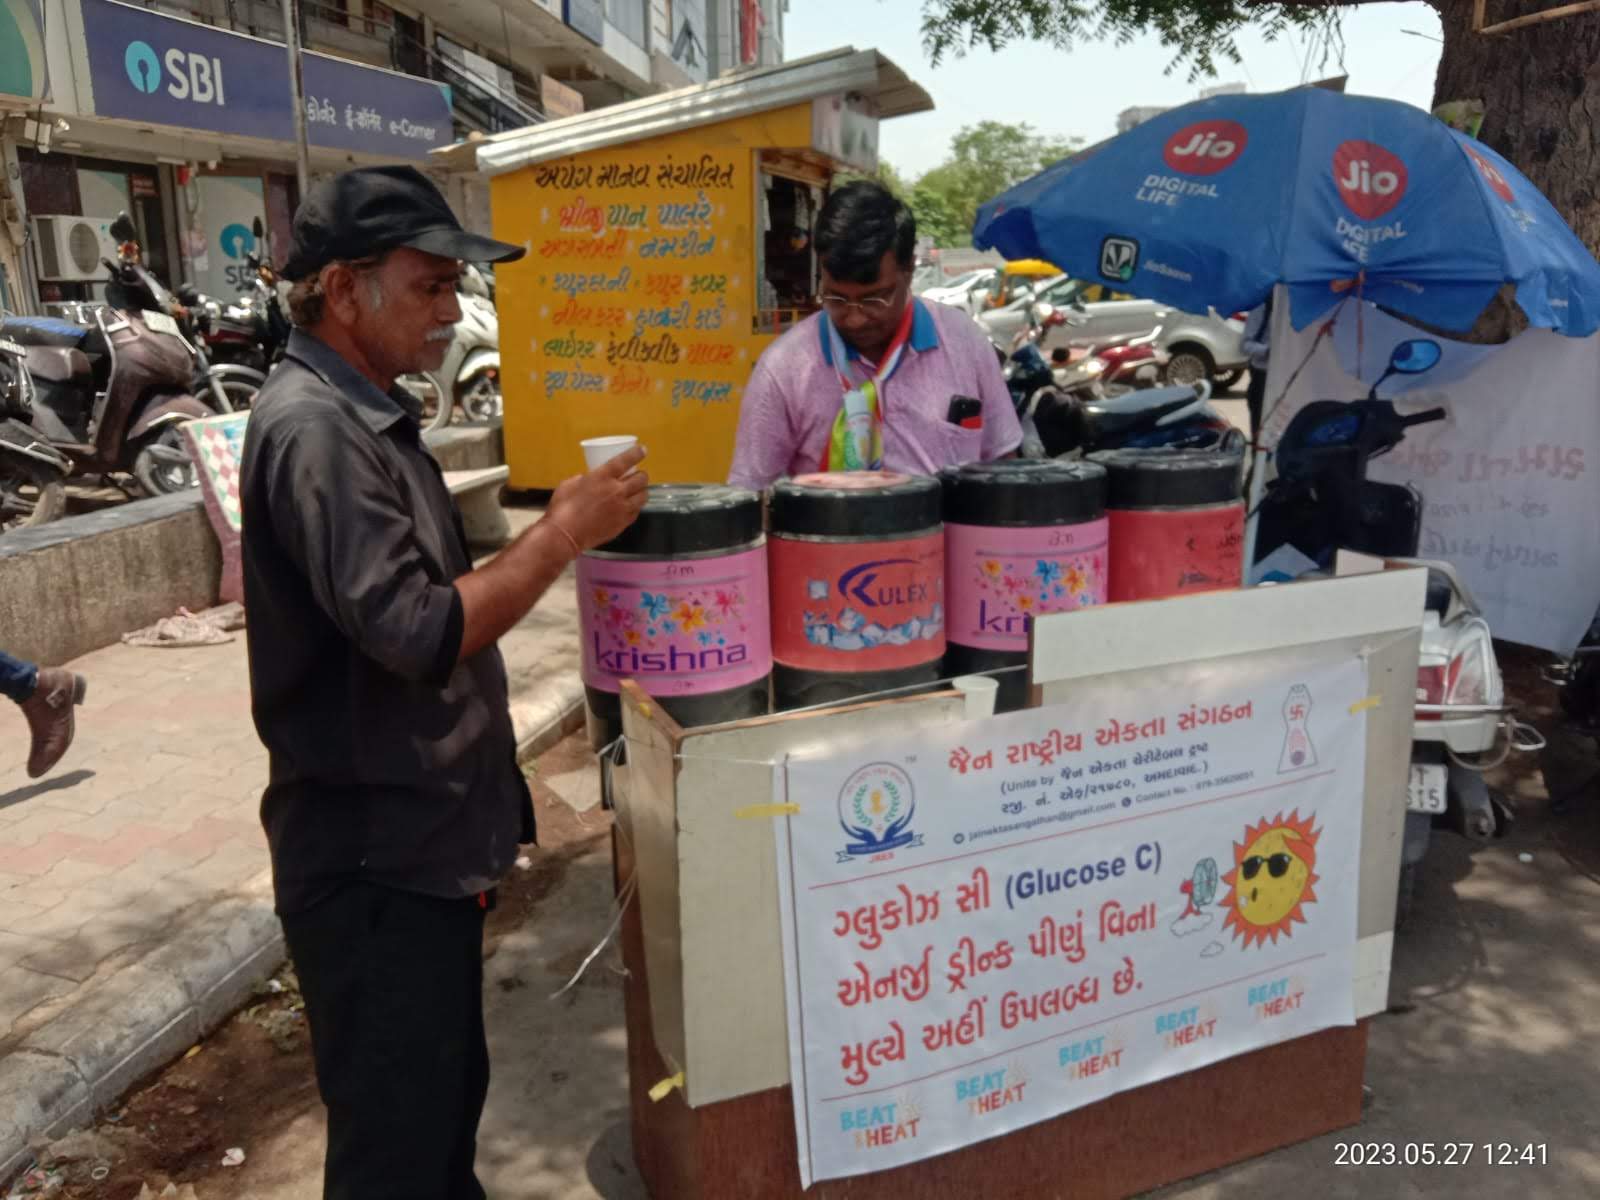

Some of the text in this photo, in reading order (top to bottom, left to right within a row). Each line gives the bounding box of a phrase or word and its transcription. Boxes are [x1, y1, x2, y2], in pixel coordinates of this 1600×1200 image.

[165, 48, 225, 105] SBI
[389, 118, 436, 141] e-Corner
[1173, 132, 1236, 159] Jio
[1143, 174, 1219, 197] DIGITAL
[1341, 160, 1398, 195] Jio
[1136, 187, 1178, 206] LIFE
[593, 631, 748, 671] krishna
[948, 700, 1253, 774] જૈન રાષ્ટ્રીય એકતા સંગઠન
[833, 842, 1162, 949] ગ્લુકોઝ સી (Glucose C)
[1028, 909, 1087, 965] પીણું
[1098, 899, 1156, 942] વિના
[1111, 956, 1143, 996] છે.
[1247, 979, 1289, 1007] BEAT
[1155, 1007, 1200, 1035] BEAT
[1059, 1036, 1105, 1067] BEAT
[955, 1069, 1007, 1102] BEAT
[840, 1102, 897, 1132] BEAT
